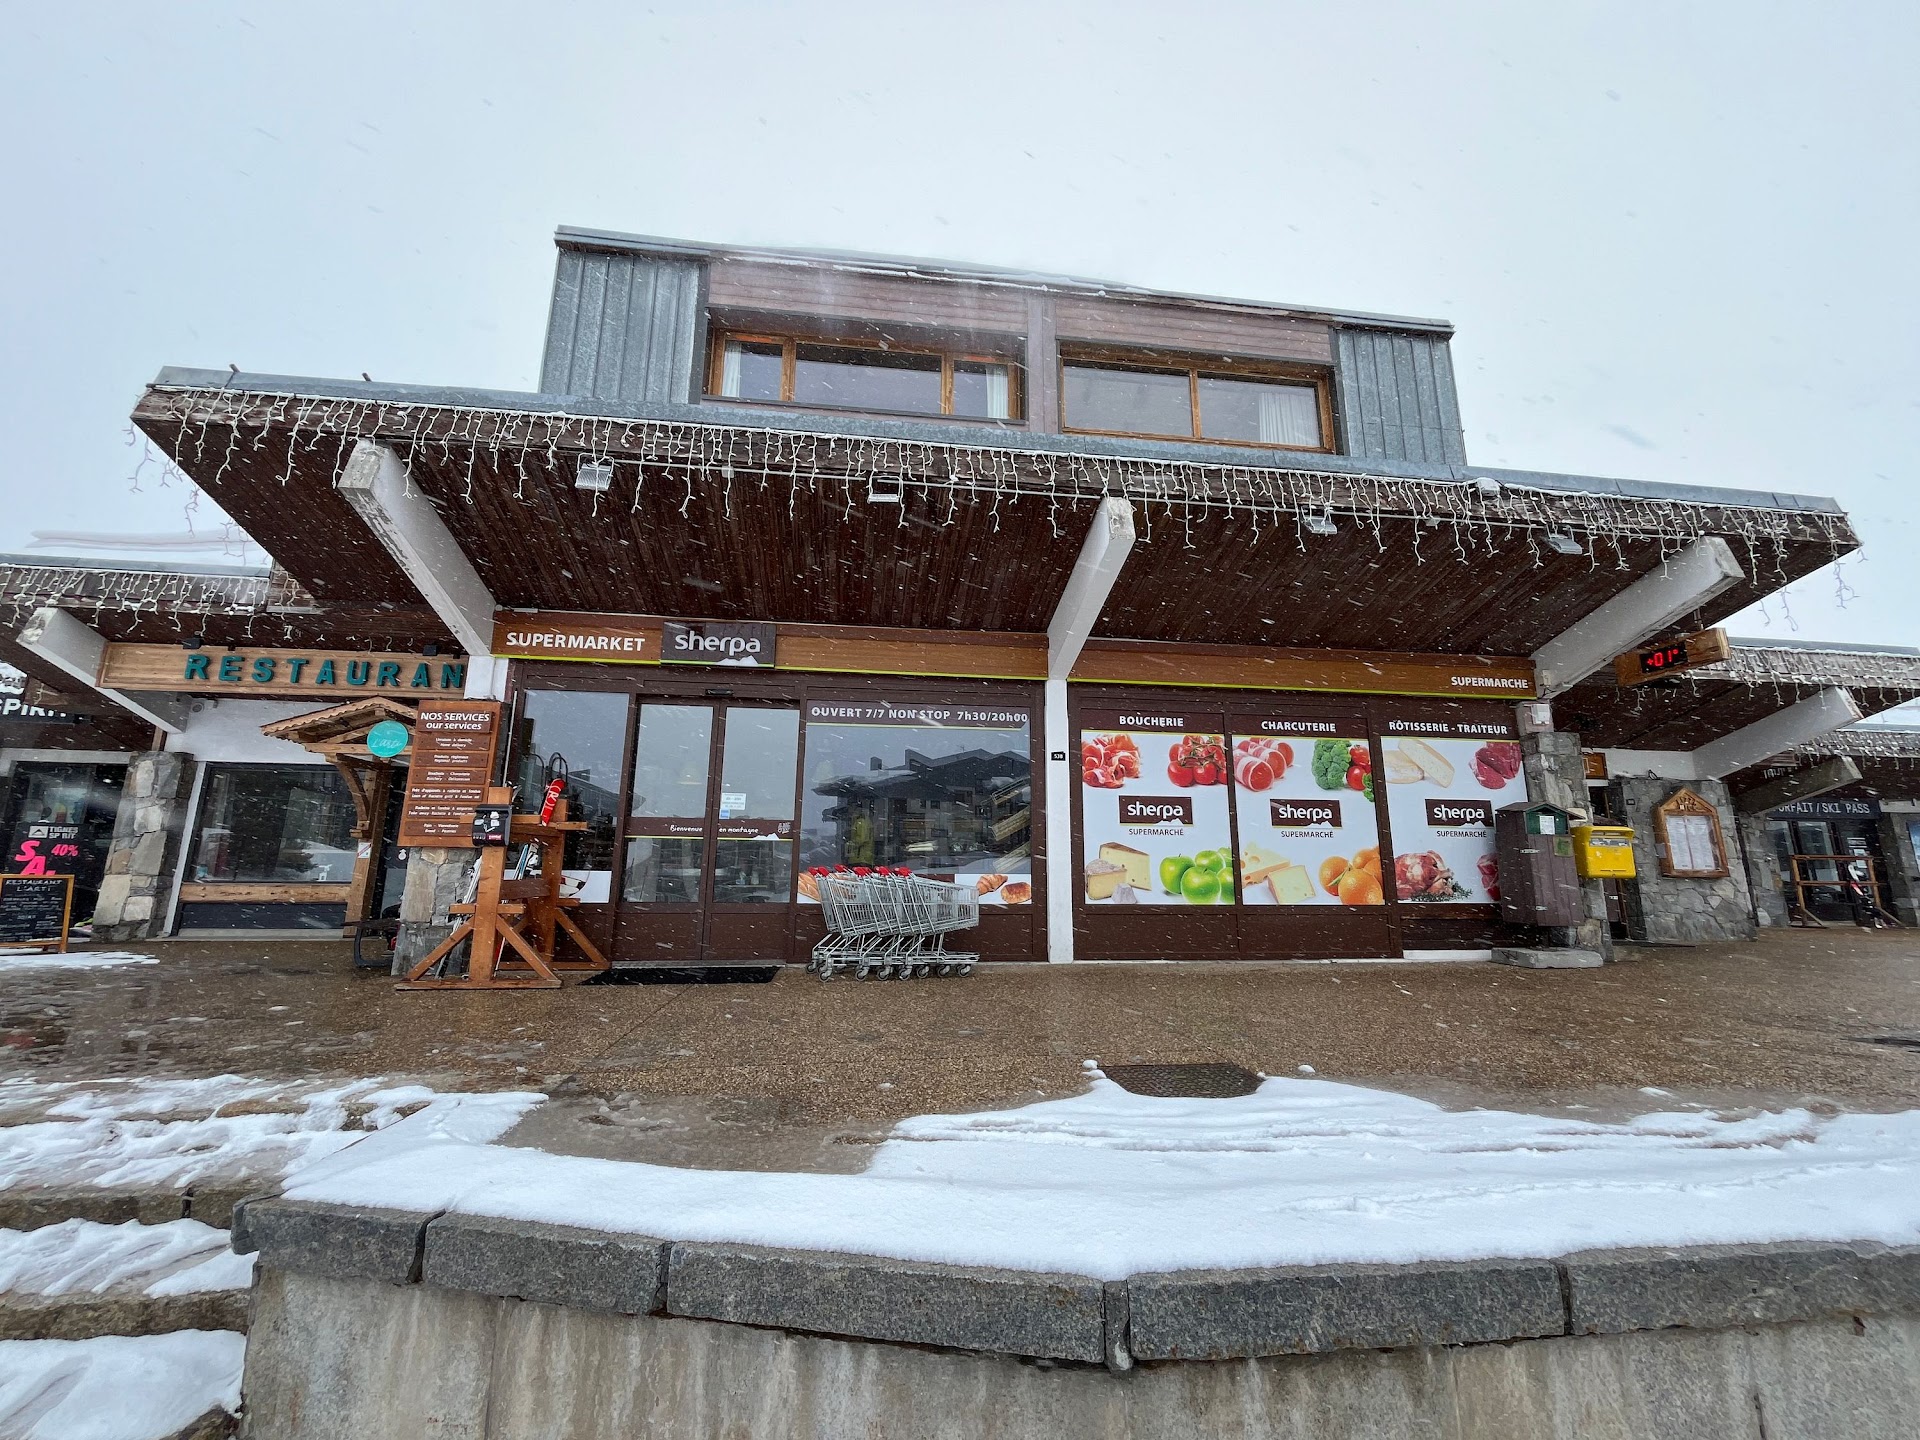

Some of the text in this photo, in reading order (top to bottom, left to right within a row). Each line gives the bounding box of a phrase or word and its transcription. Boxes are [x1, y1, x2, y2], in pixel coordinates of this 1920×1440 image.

[506, 630, 762, 656] SUPERMARKET sherpa
[184, 653, 465, 689] RESTAURAN
[1451, 676, 1529, 689] SUPERMARCHE
[420, 712, 490, 722] NOS SERVICES
[811, 706, 1028, 723] OUVERT 7/7 NON STOP 7h30/20h00
[444, 721, 482, 730] services
[1119, 715, 1184, 728] BOUCHERIE
[1261, 720, 1337, 733] CHARCUTERIE
[1388, 720, 1449, 733] RÔTISSERIE
[1457, 723, 1508, 736] TRAITEUR
[1127, 801, 1184, 819] sherpa
[1278, 804, 1333, 822] sherpa
[1433, 804, 1485, 822] sherpa
[1821, 802, 1842, 813] SKI
[1845, 803, 1871, 814] PASS
[670, 824, 703, 833] Bienvenue
[728, 826, 759, 835] montagne
[1128, 827, 1184, 836] SUPERMARCHÉ
[1281, 830, 1334, 838] SUPERMARCHÉ
[1436, 829, 1487, 838] SUPERMARCHÉ
[51, 844, 79, 857] 40%
